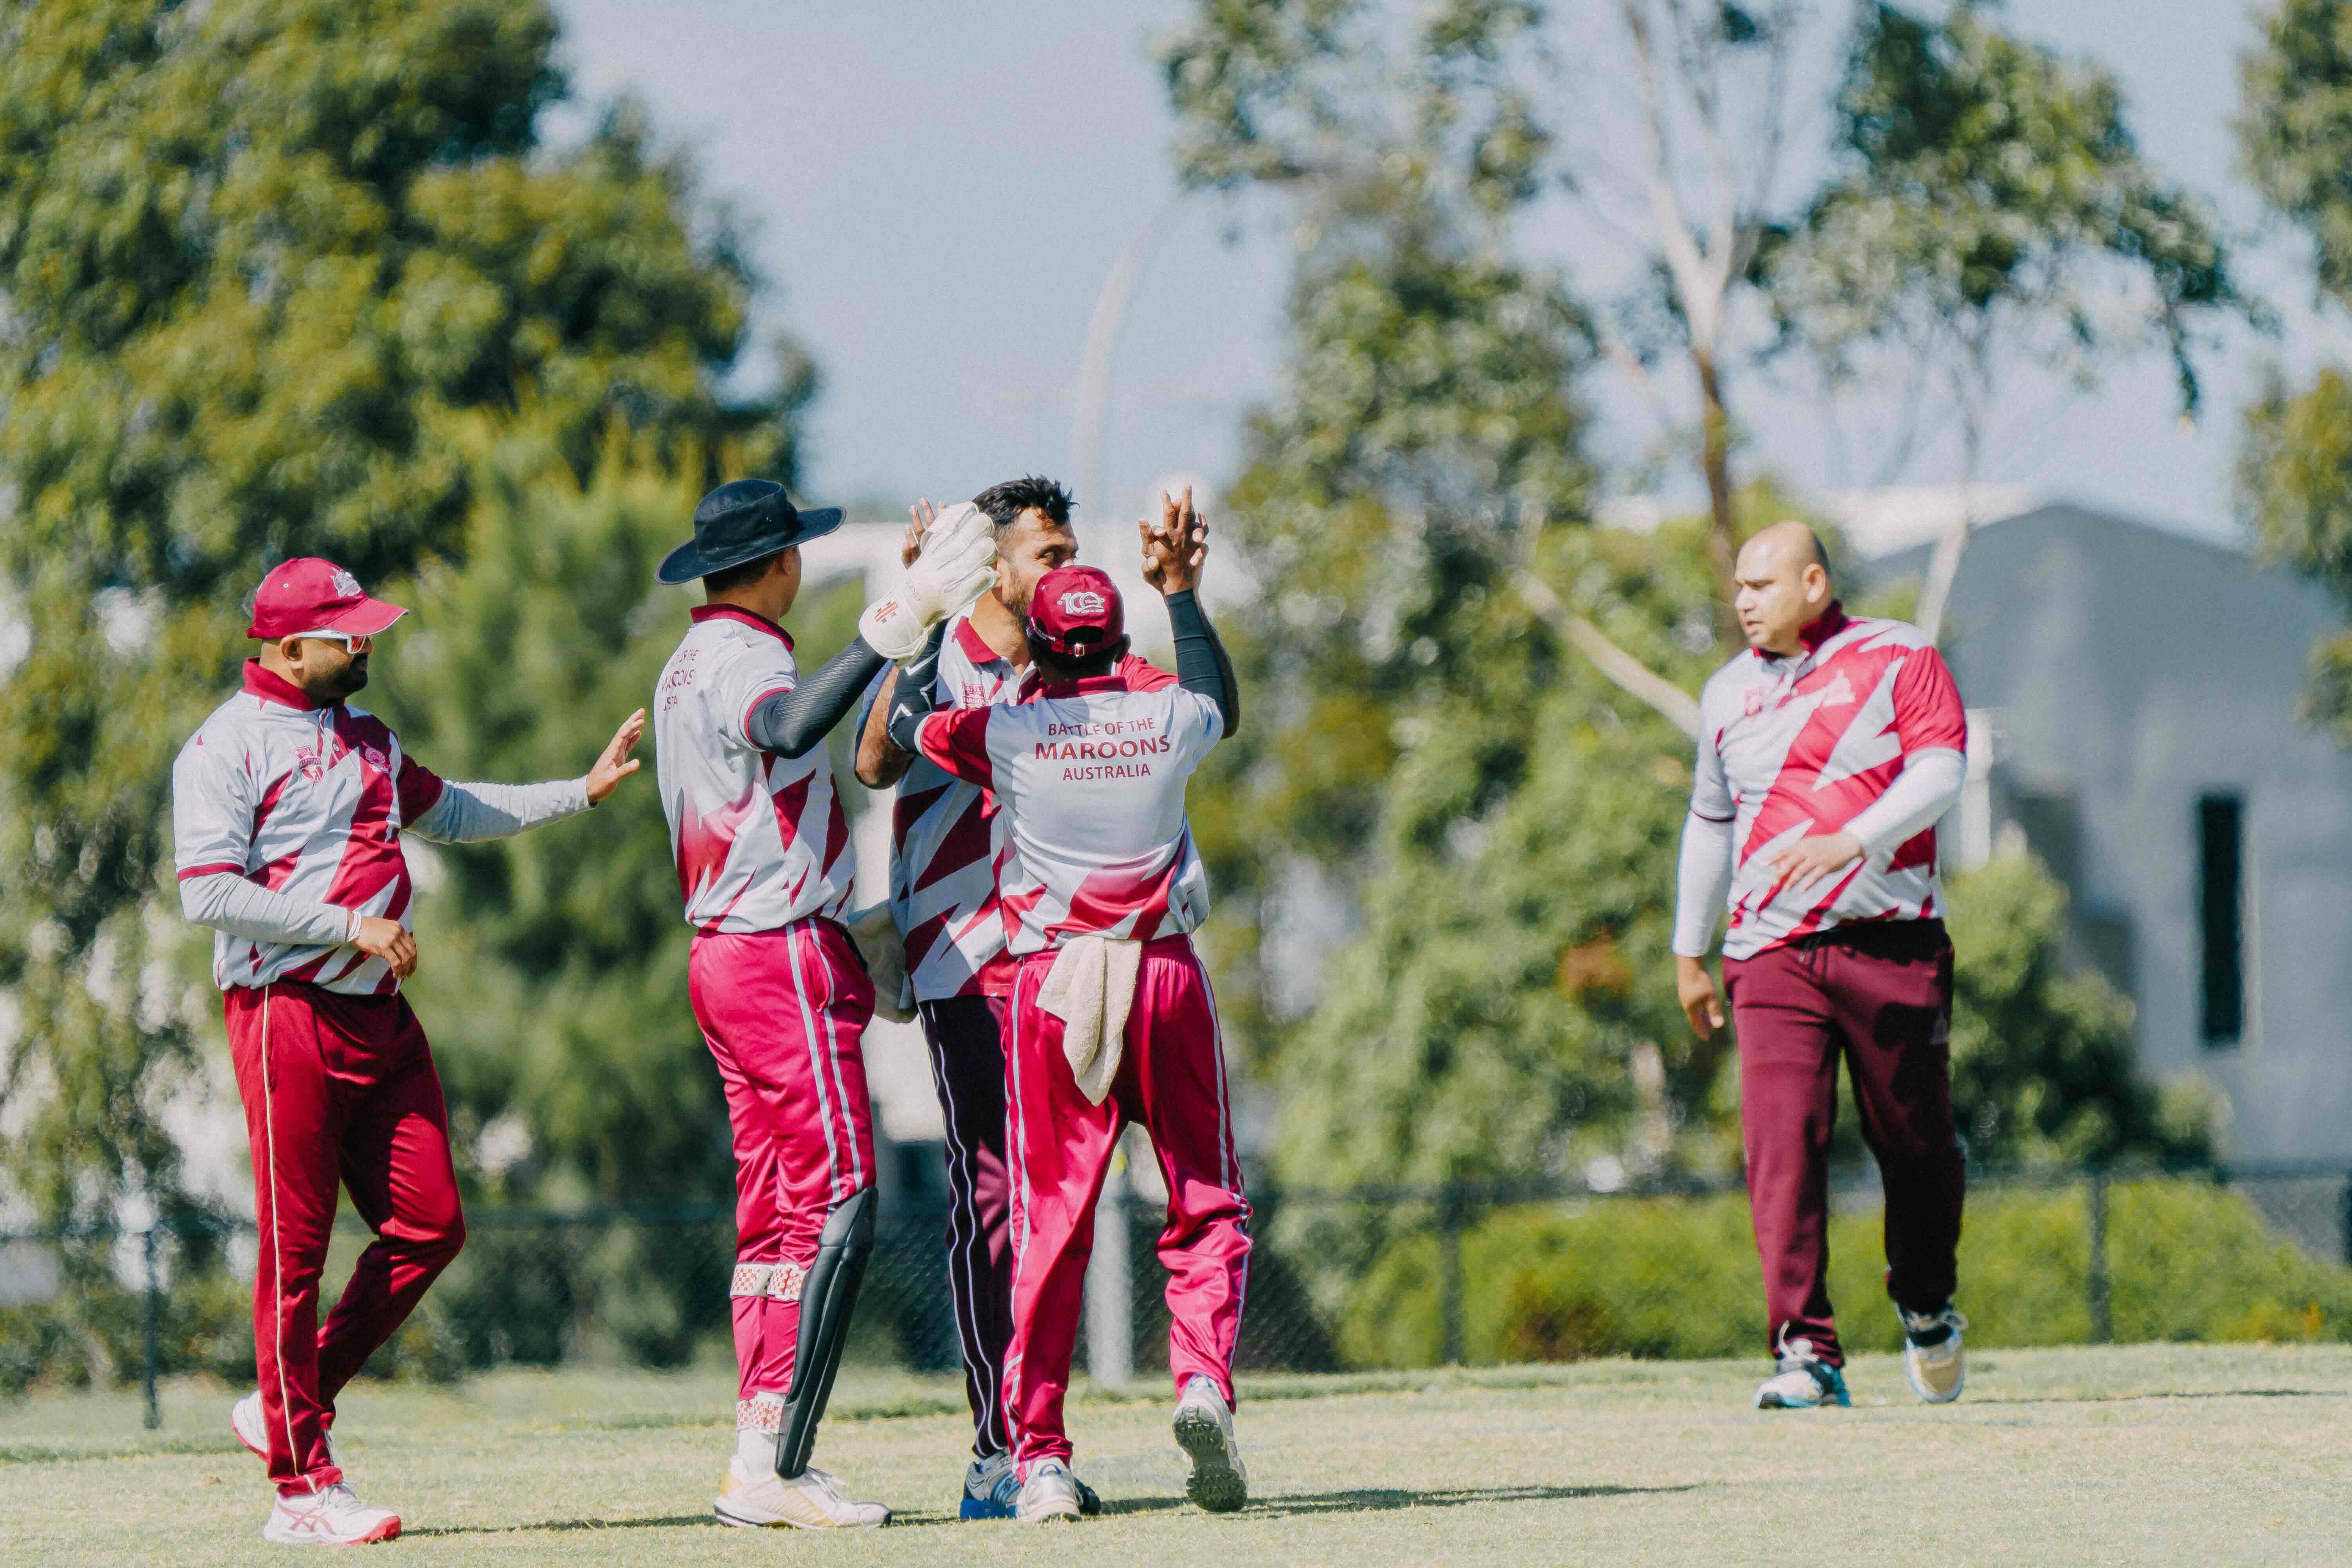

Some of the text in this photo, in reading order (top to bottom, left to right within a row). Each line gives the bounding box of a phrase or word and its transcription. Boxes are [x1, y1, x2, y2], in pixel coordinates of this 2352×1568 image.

[1048, 718, 1156, 737] BATTLE OF THE
[1035, 735, 1170, 760] MAROONS
[1063, 764, 1151, 780] AUSTRALIA
